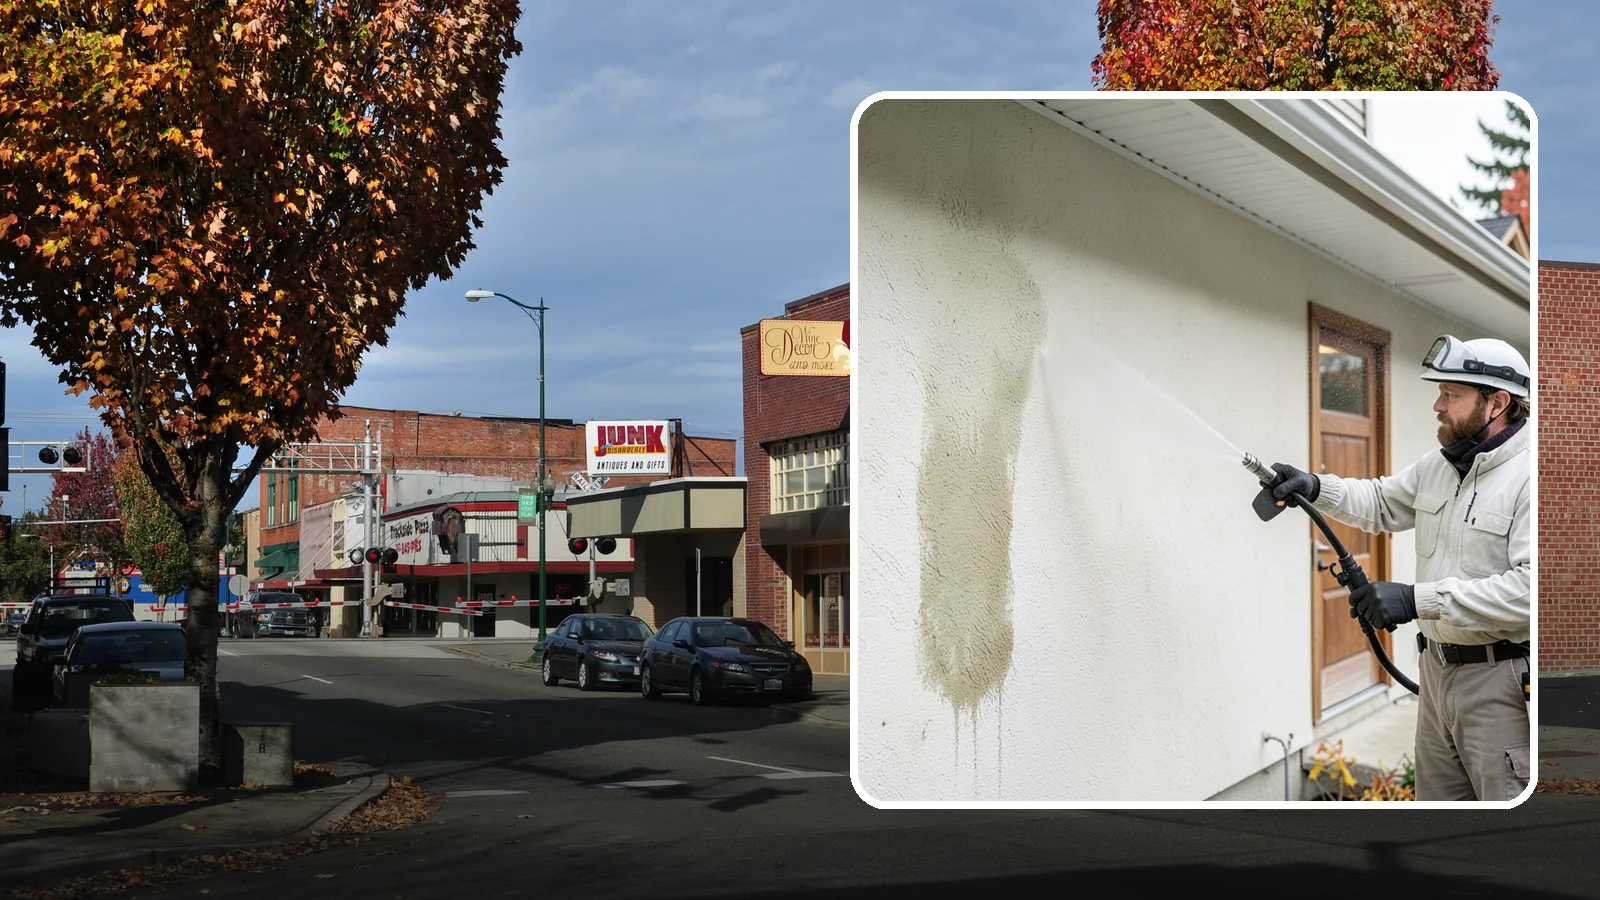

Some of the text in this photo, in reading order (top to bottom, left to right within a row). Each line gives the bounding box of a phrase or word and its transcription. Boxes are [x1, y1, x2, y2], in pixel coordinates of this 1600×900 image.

[595, 425, 665, 457] JUNK
[607, 446, 646, 454] DISORDERLY
[597, 460, 665, 470] ANTIQUES AND GIFTS
[352, 498, 365, 511] CRO
[390, 519, 429, 540] Trackside Pizza
